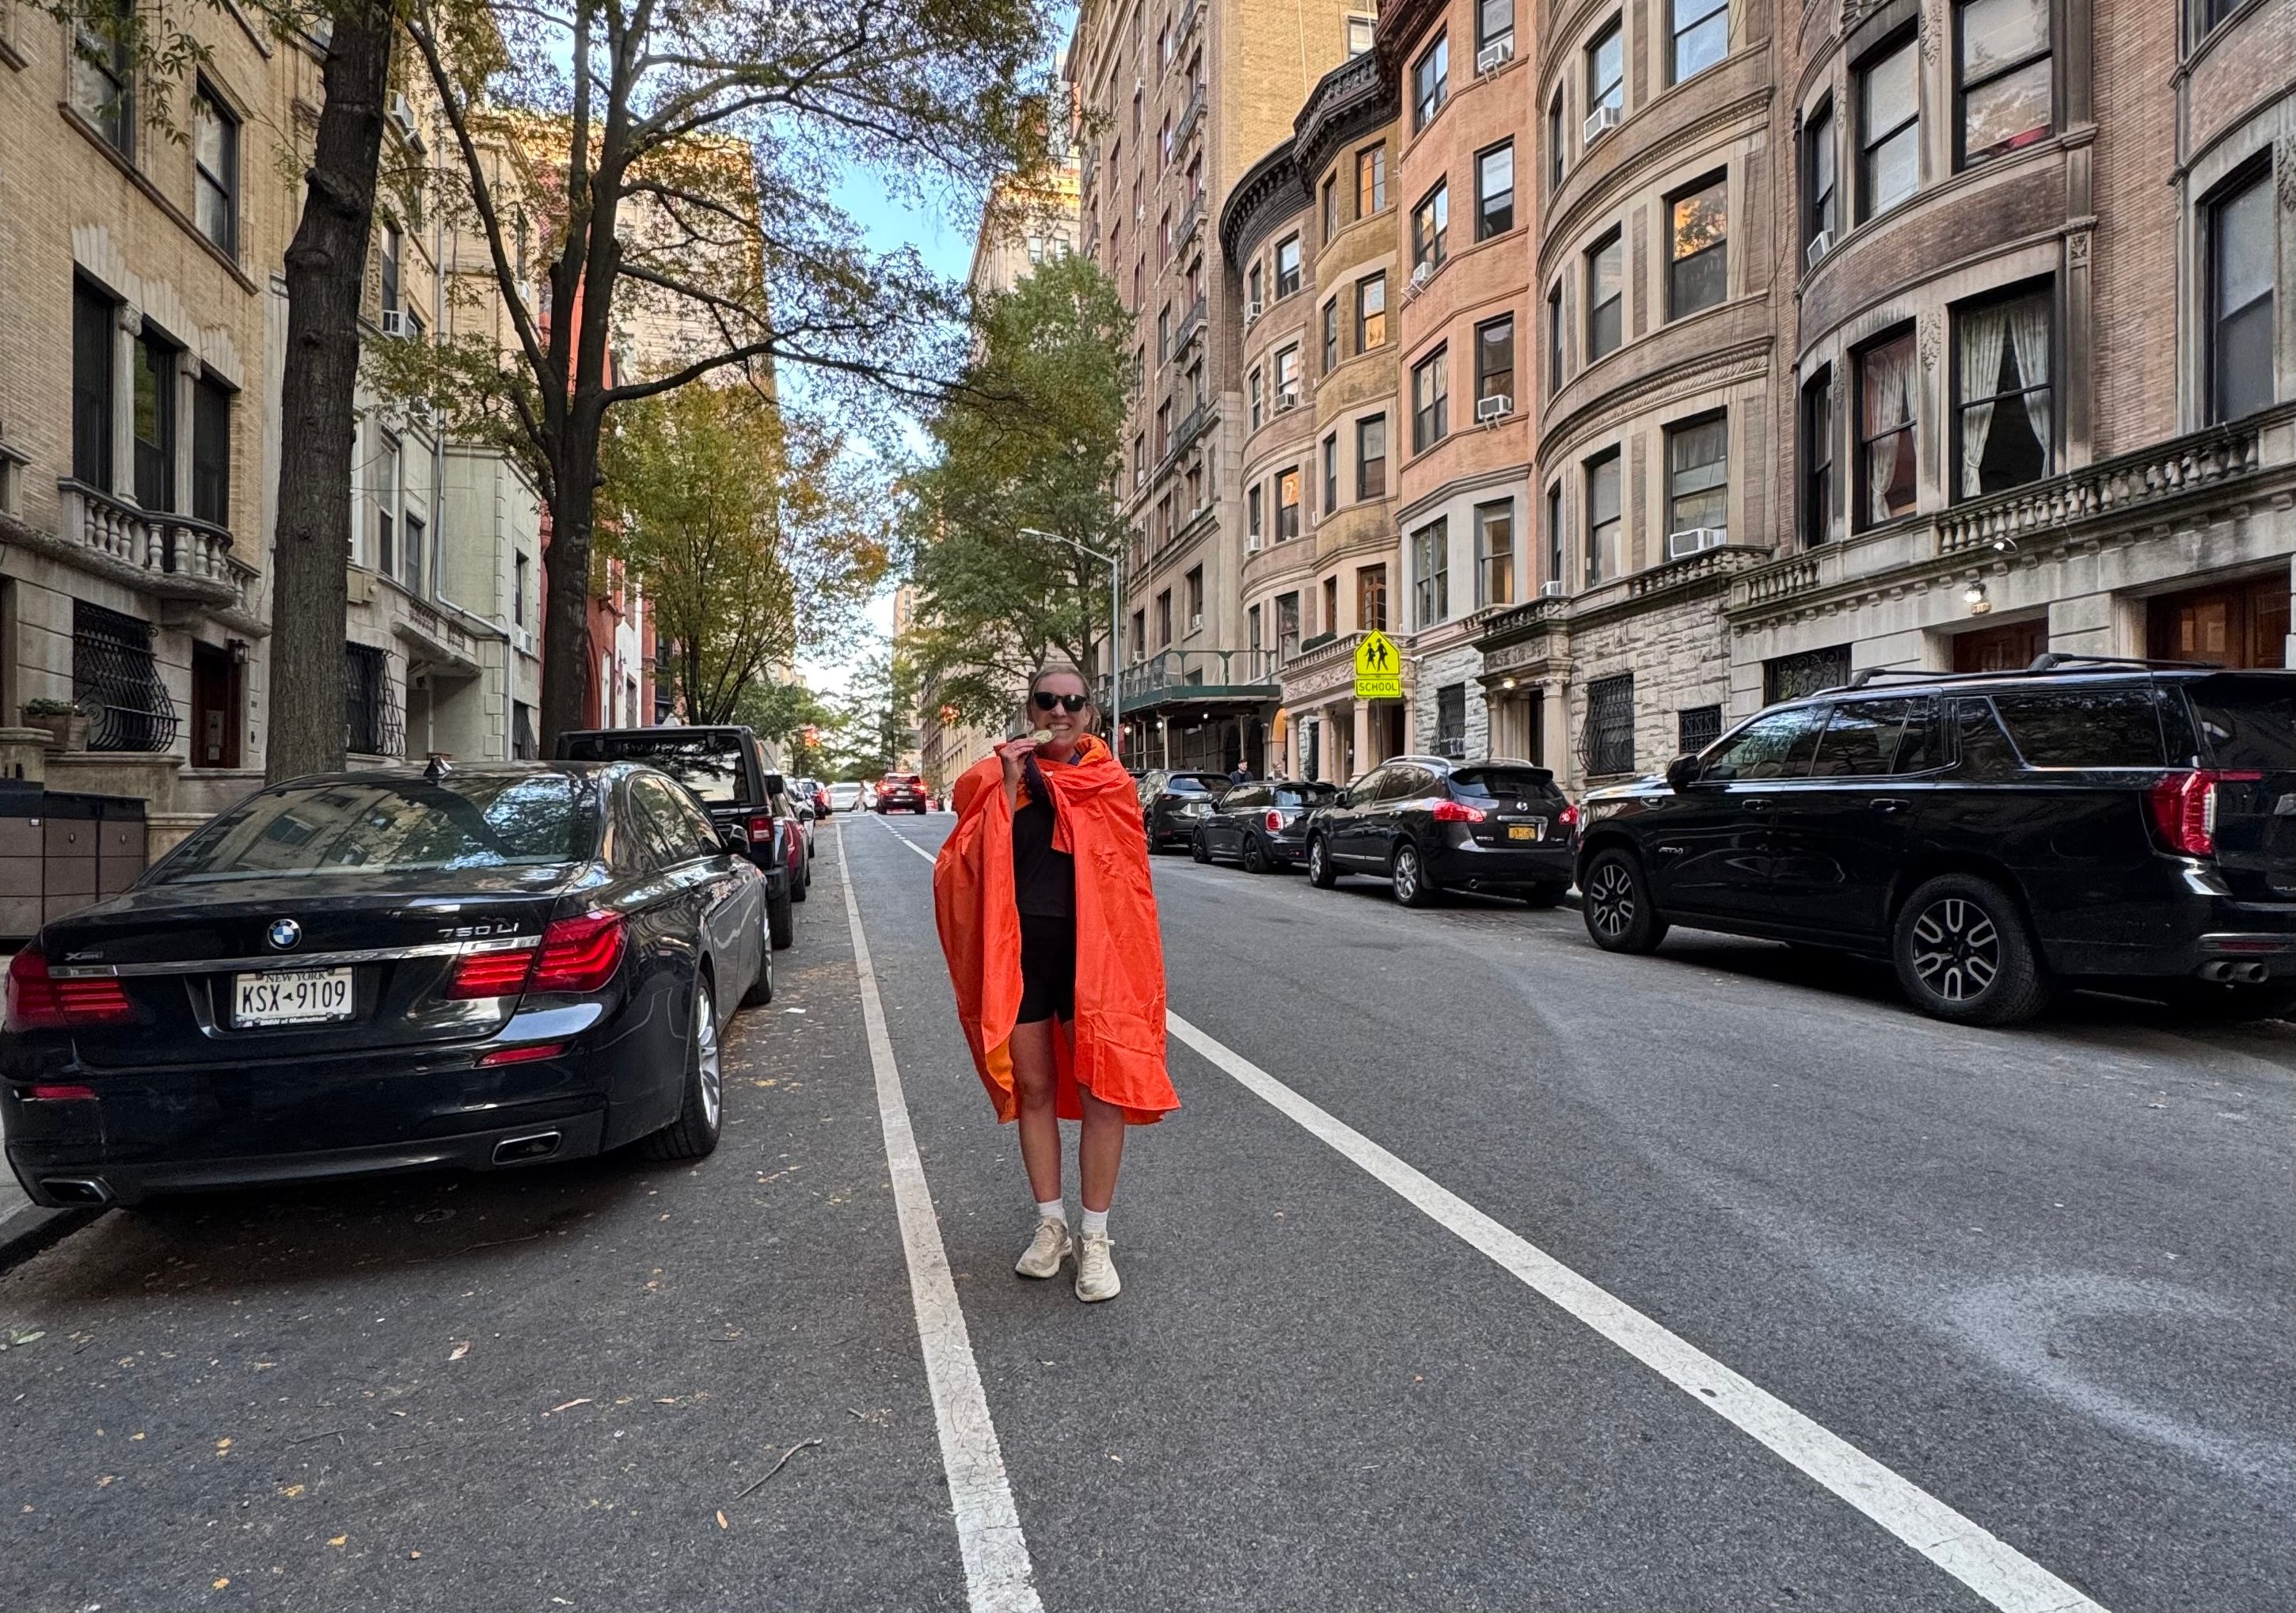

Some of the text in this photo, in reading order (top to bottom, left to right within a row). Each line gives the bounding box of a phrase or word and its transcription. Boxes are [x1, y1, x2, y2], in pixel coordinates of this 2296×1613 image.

[1359, 682, 1397, 691] SCHOOL
[265, 971, 326, 983] NEW YORK
[242, 980, 345, 1013] KSX 9109
